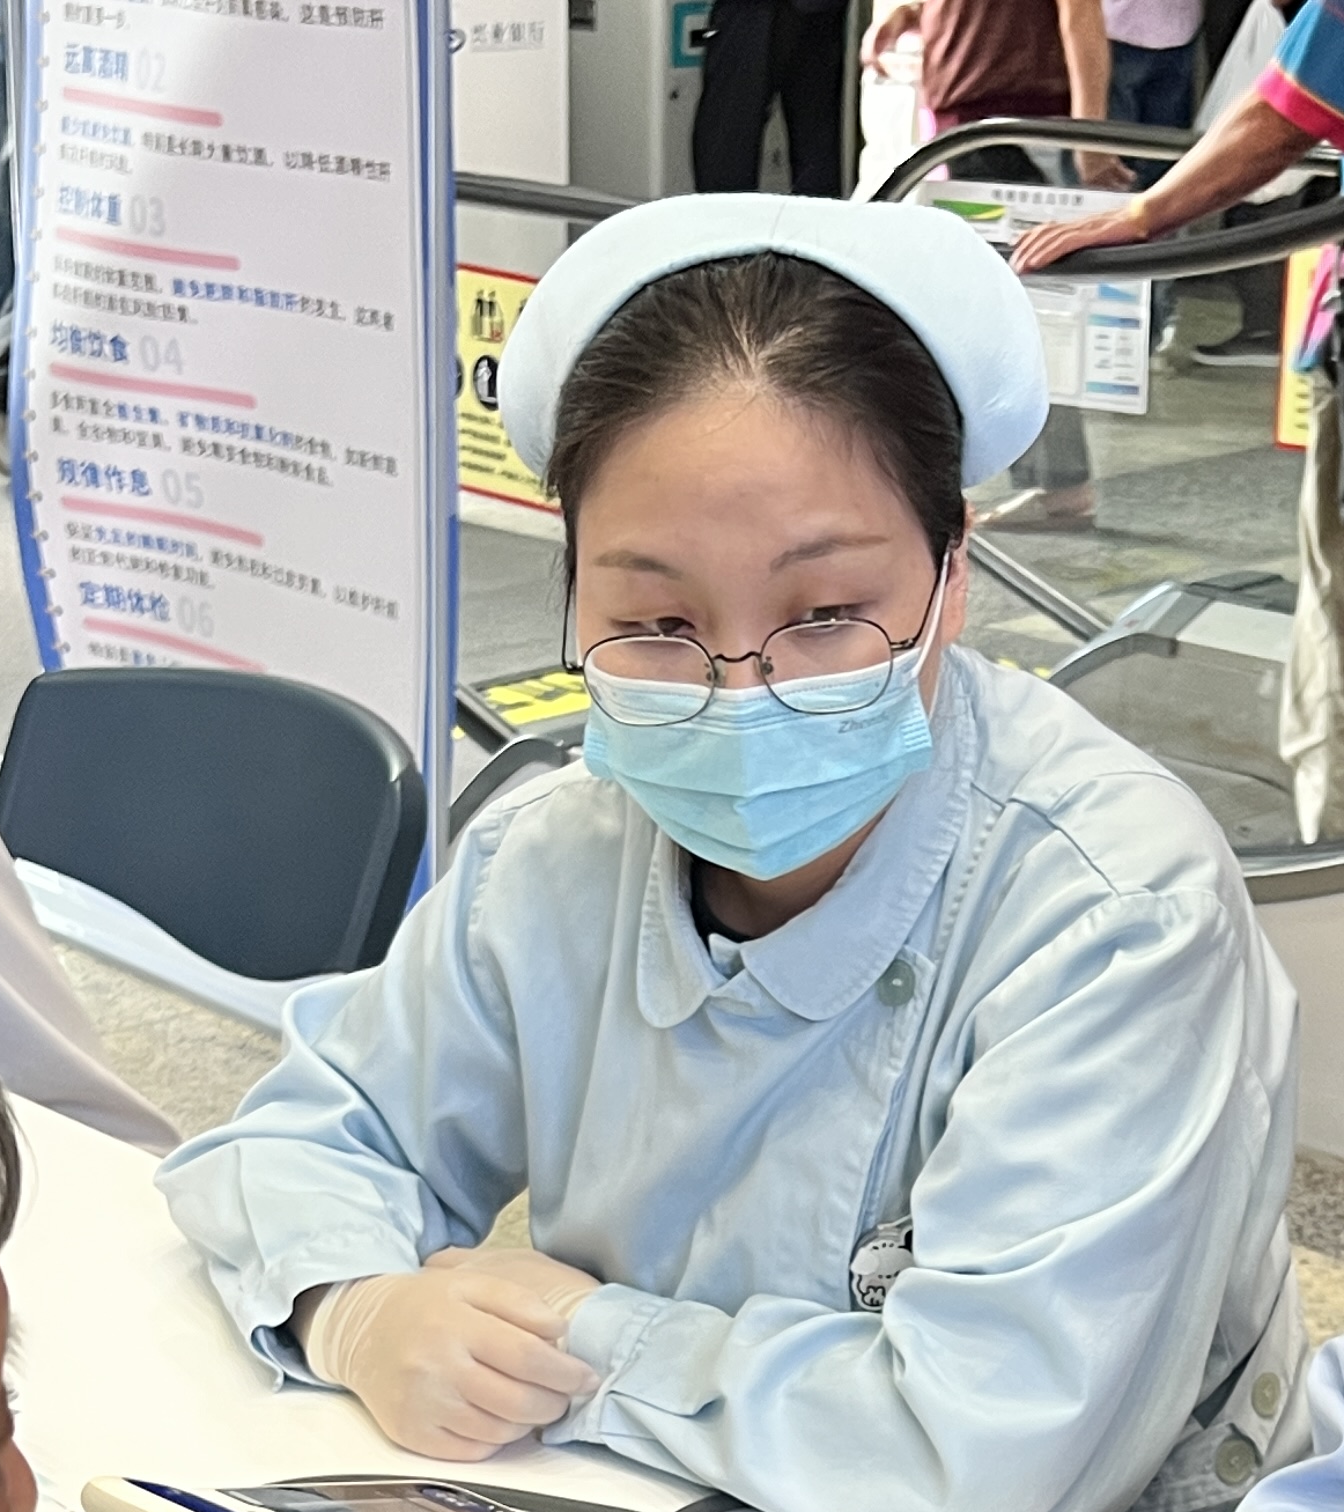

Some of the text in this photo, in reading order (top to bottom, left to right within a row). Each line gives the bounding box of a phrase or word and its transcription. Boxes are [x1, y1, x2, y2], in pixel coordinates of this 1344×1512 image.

[136, 49, 167, 91] 02
[130, 193, 166, 237] 03
[138, 336, 183, 375] 04
[162, 469, 203, 509] 05
[79, 581, 215, 638] 定期体检 06
